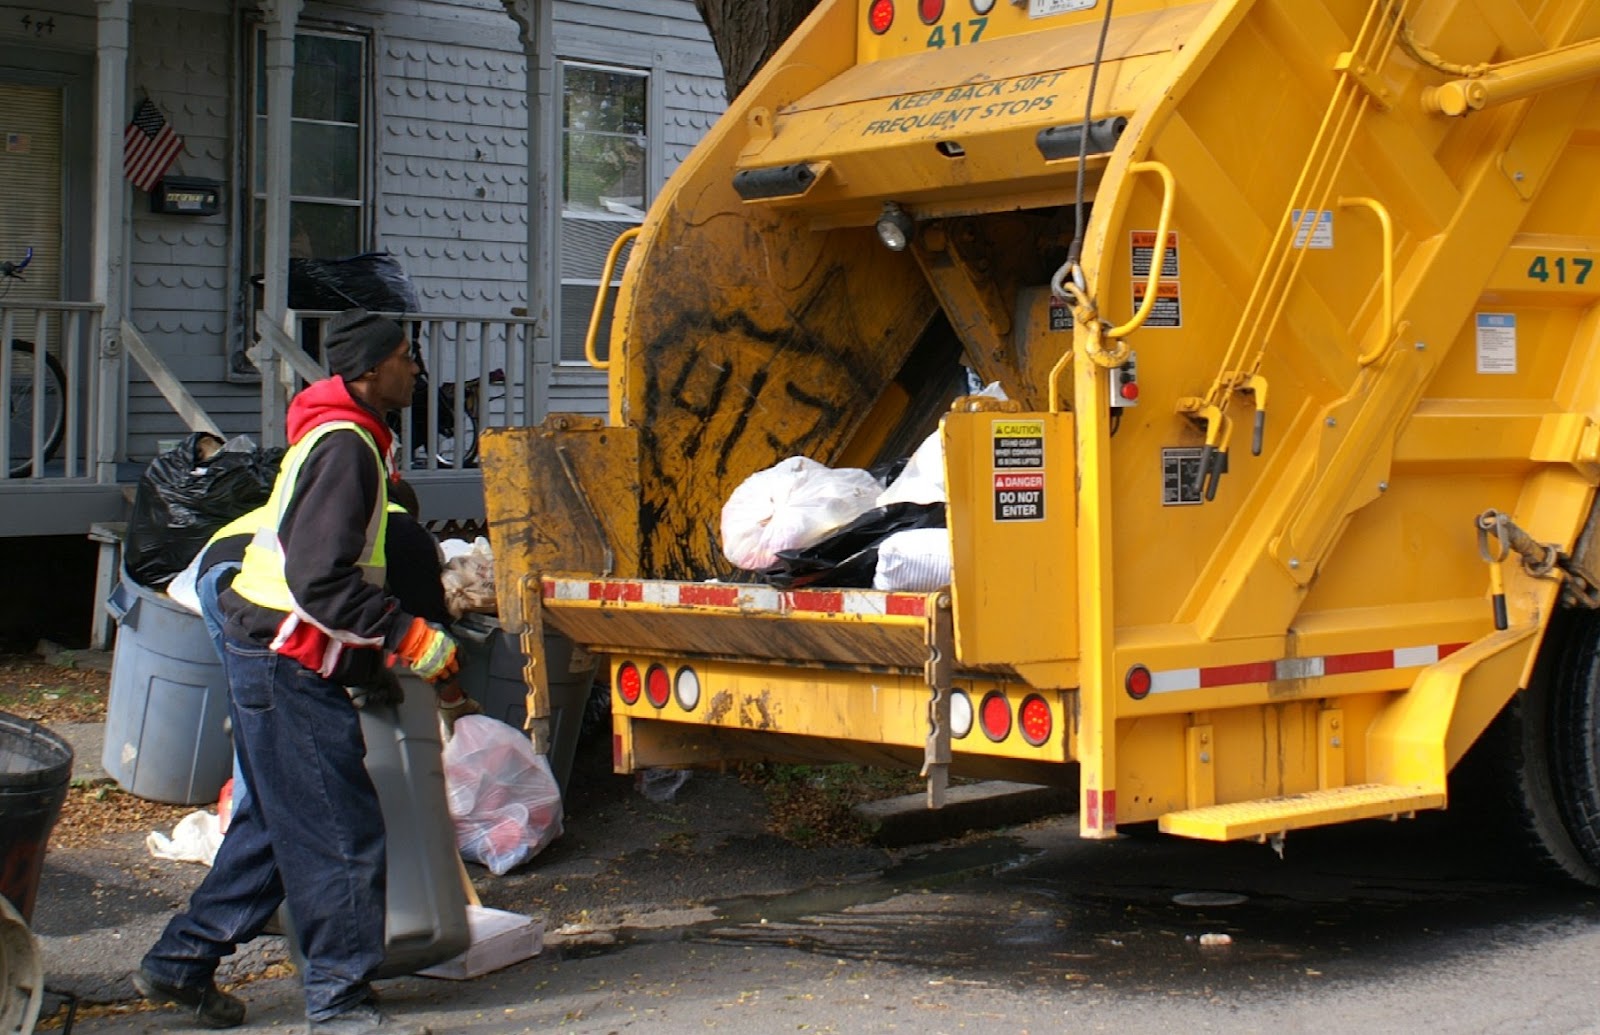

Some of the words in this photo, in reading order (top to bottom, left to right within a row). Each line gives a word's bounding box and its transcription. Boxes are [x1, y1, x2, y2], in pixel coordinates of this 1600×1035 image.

[926, 17, 988, 49] 417
[887, 90, 943, 112] KEEP
[944, 79, 1003, 103] BACK
[1009, 72, 1066, 94] 50FT
[861, 105, 978, 136] FREQUENT
[980, 95, 1058, 119] STOPS
[1527, 256, 1593, 284] 417
[1003, 425, 1041, 434] CAUTION
[1004, 477, 1042, 487] DANGER
[999, 492, 1015, 503] DO
[1017, 492, 1039, 503] NOT
[1002, 505, 1036, 516] ENTER
